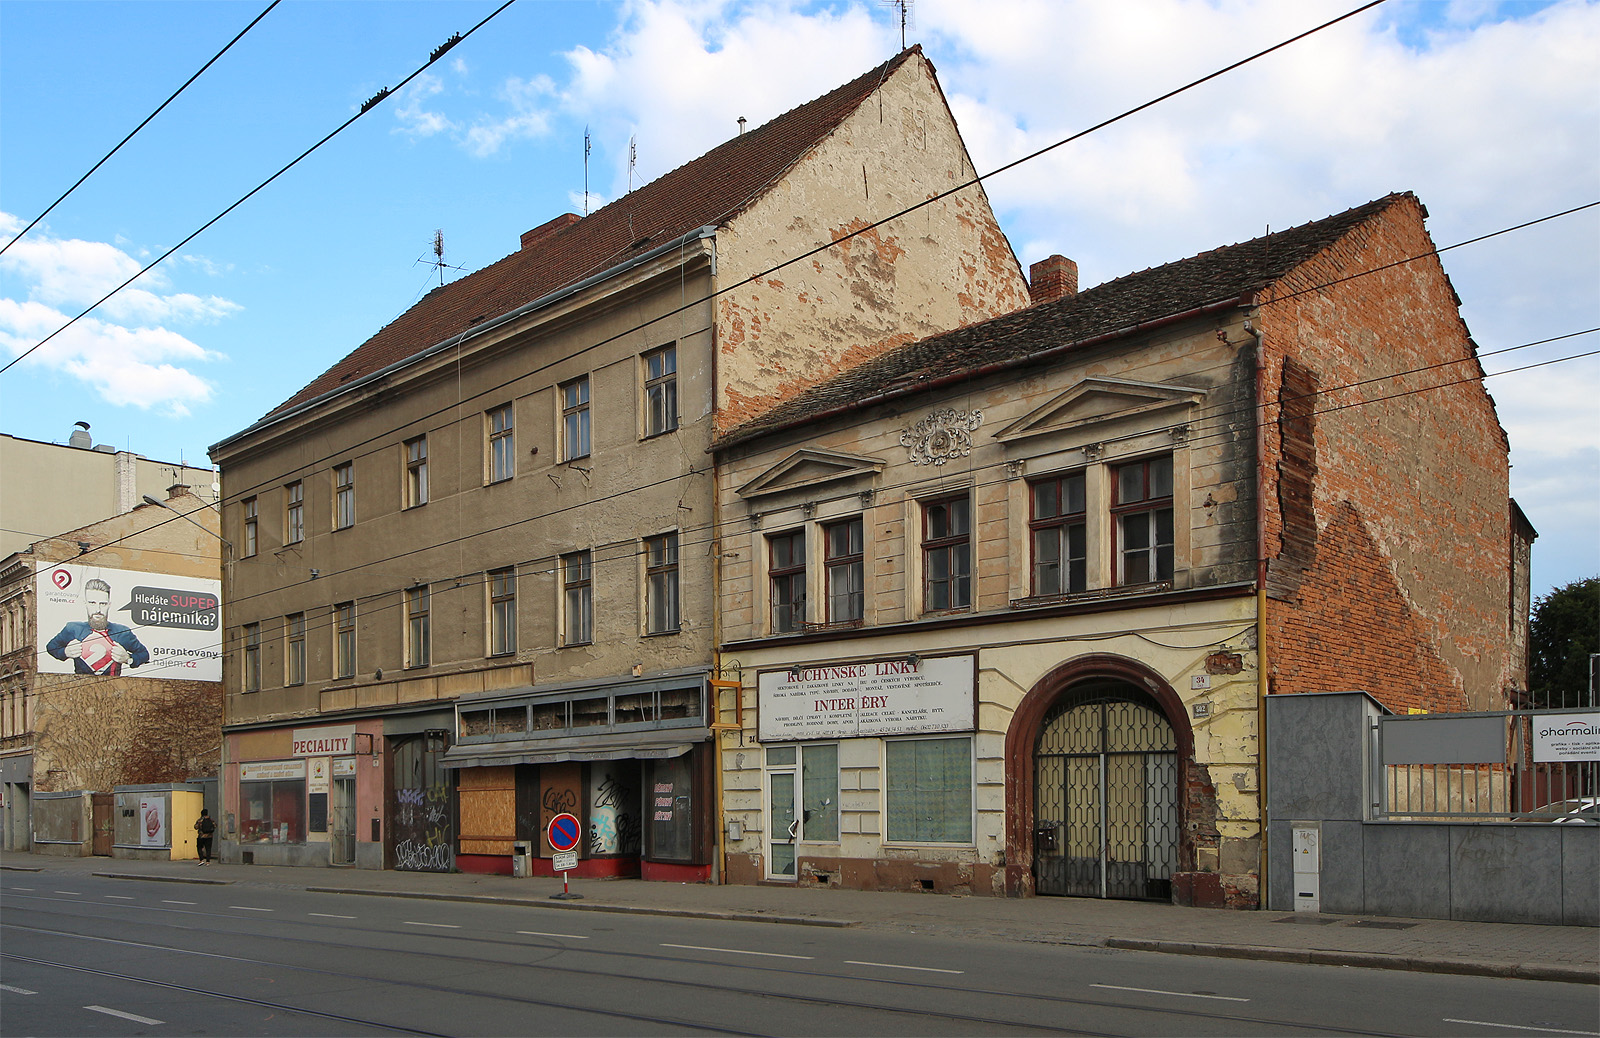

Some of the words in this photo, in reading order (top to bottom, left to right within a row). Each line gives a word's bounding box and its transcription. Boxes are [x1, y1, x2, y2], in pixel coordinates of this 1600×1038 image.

[136, 594, 168, 605] Hledáte
[170, 595, 215, 609] SUPER
[142, 607, 216, 626] nájemníka?
[875, 662, 918, 676] LINKY
[1540, 726, 1600, 738] pharmali
